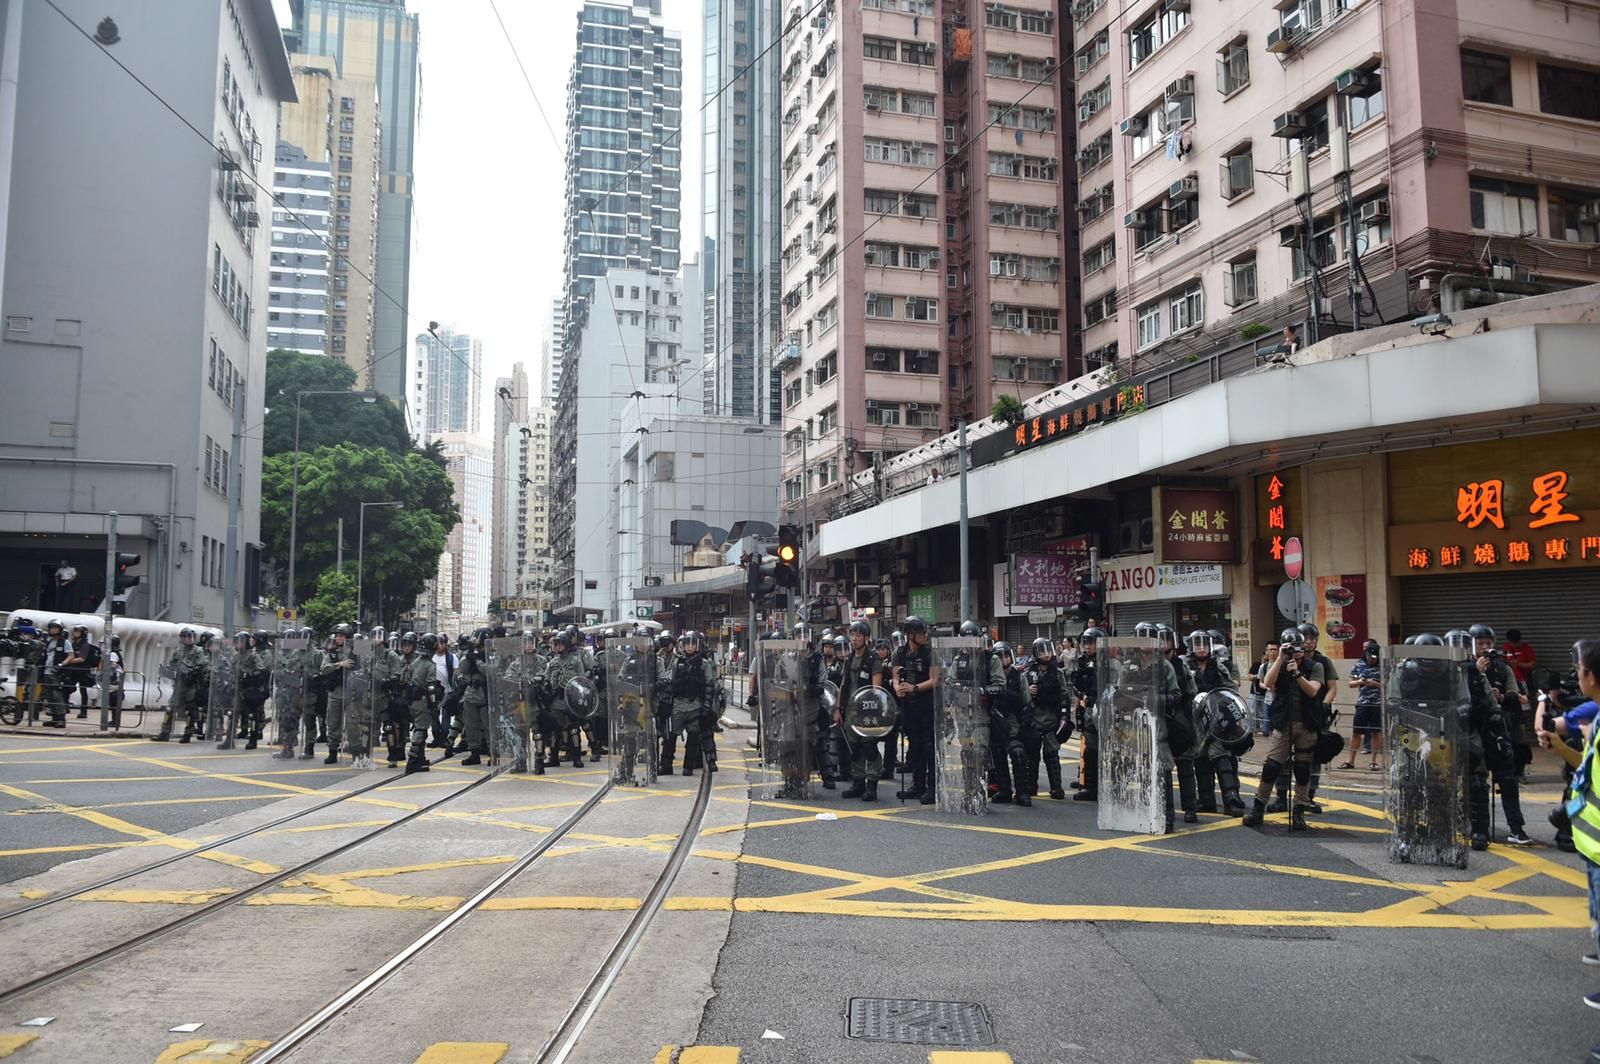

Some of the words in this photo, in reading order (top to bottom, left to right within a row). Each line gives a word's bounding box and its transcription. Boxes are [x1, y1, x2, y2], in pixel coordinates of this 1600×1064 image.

[1457, 471, 1580, 529] 明星
[1188, 576, 1198, 584] LIFE
[1031, 593, 1055, 603] 2540
